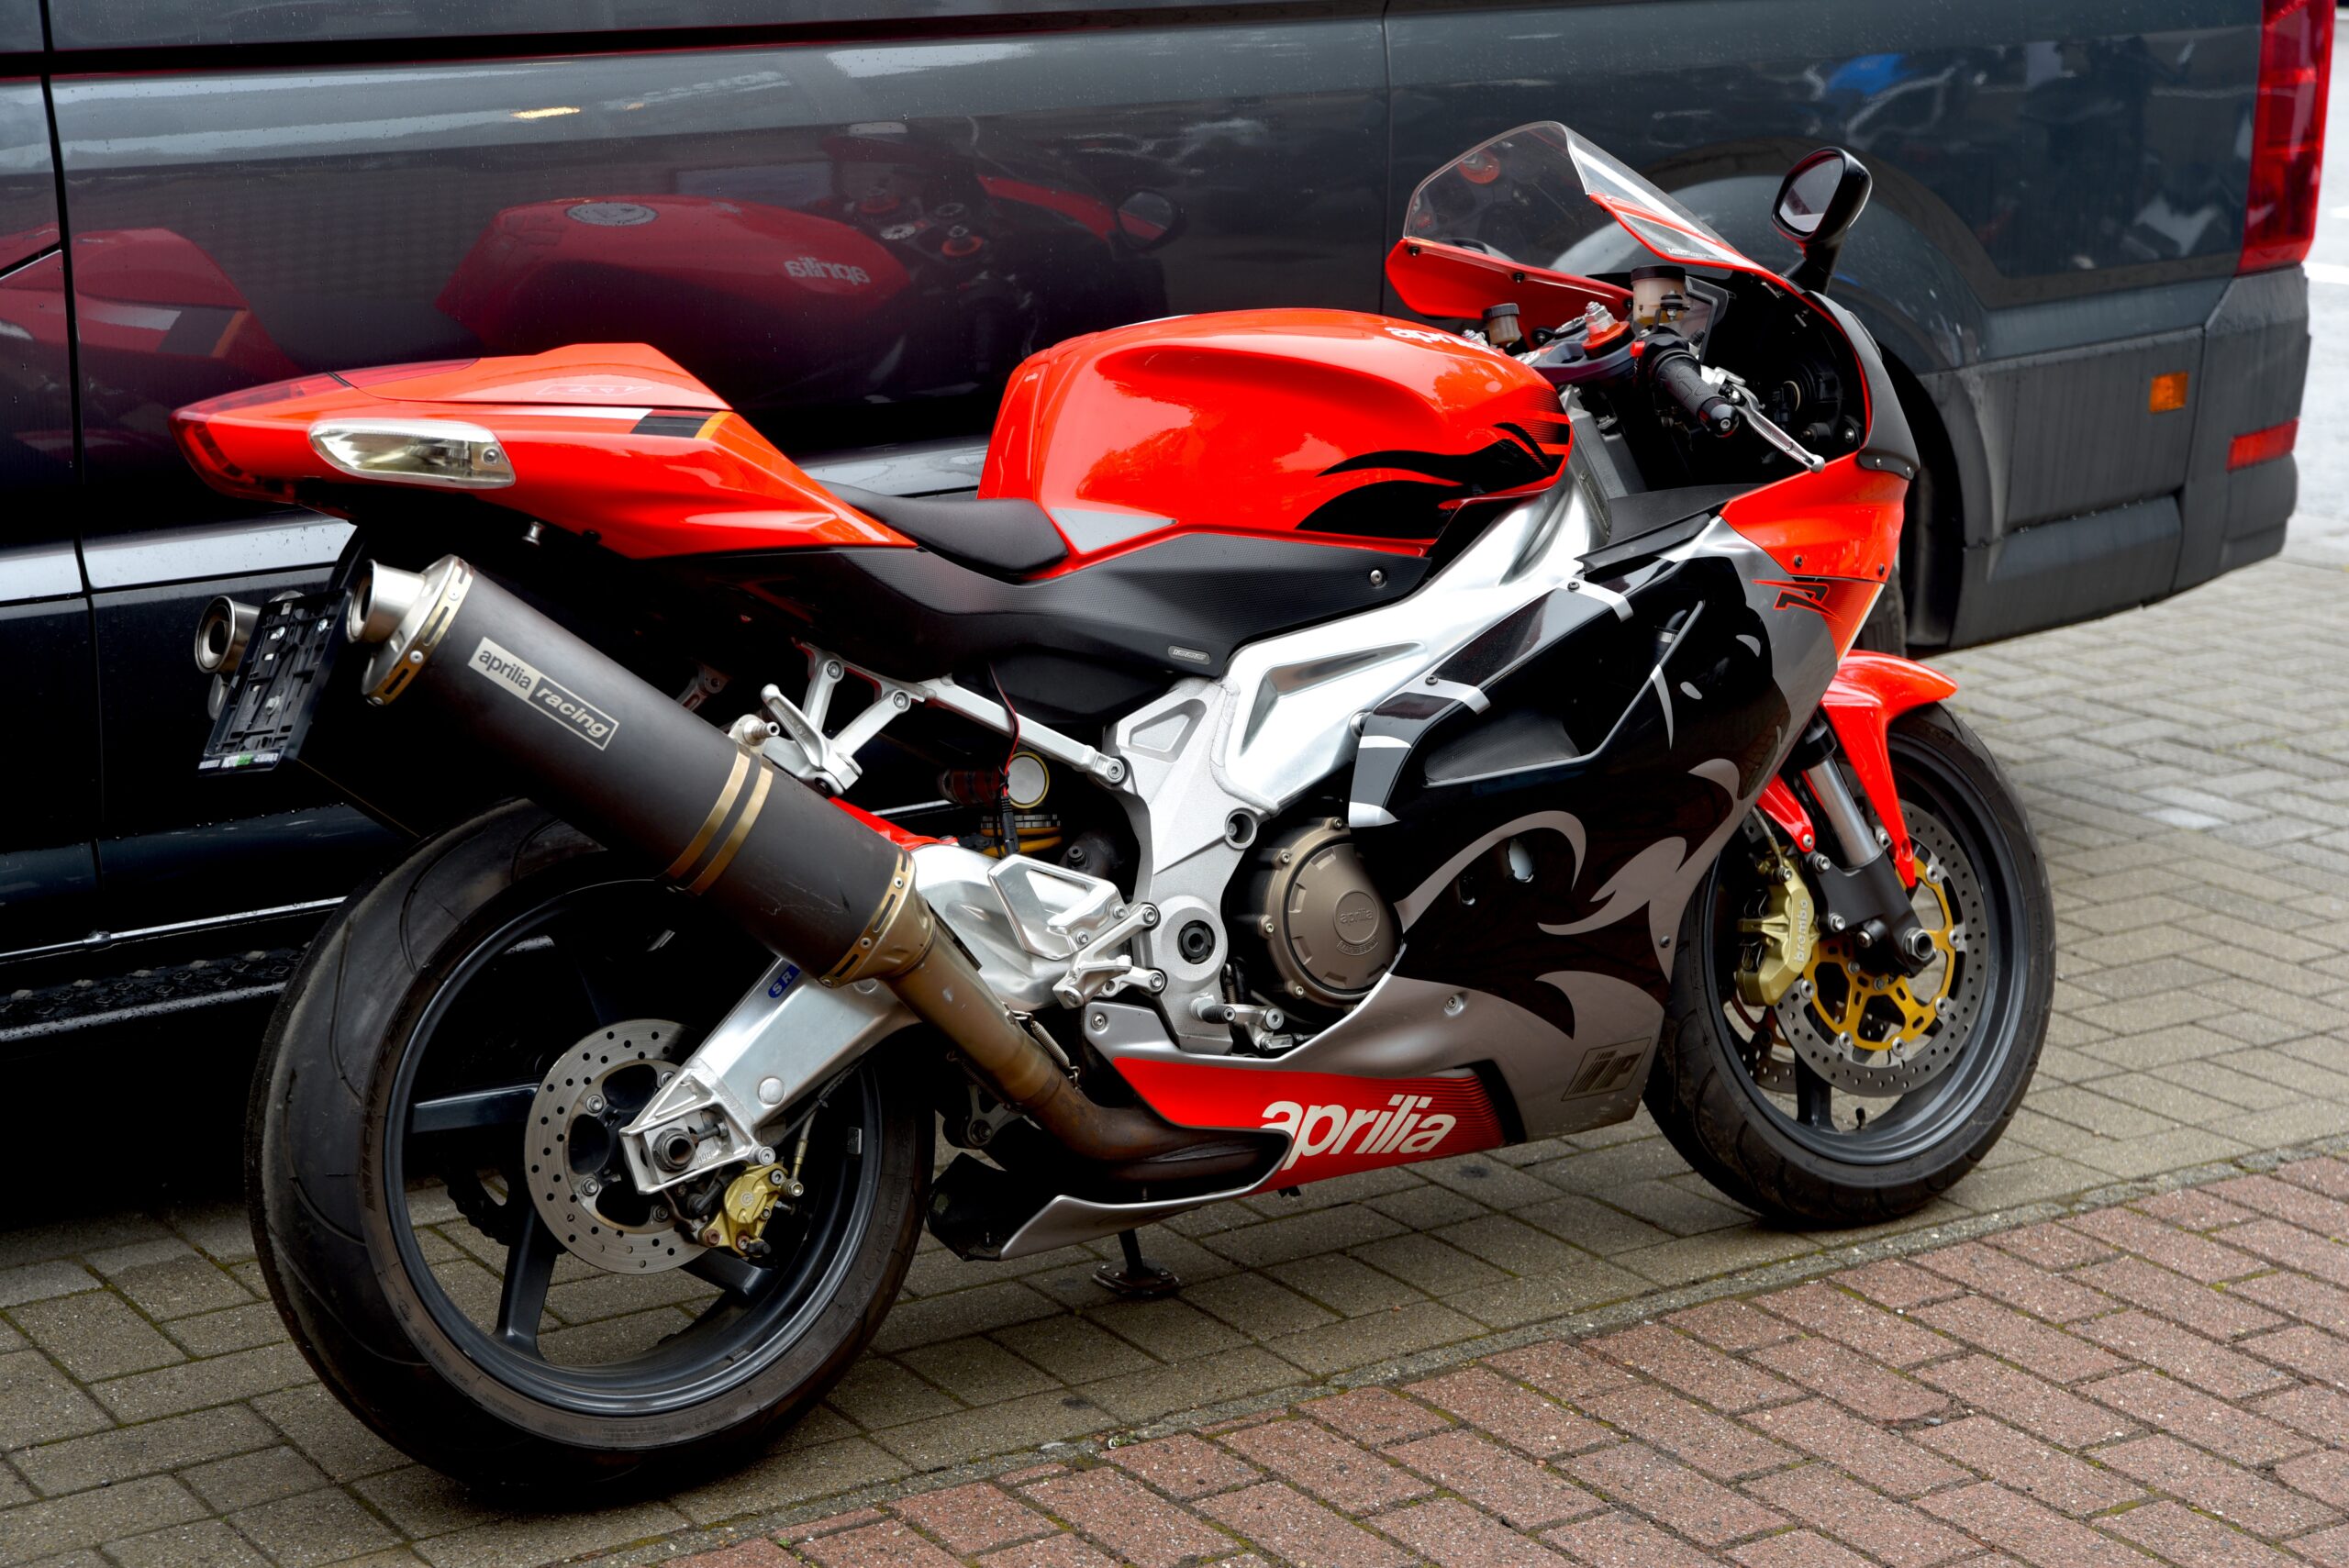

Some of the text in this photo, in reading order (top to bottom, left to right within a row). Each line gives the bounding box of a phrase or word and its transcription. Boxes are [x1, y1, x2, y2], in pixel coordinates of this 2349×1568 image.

[479, 649, 609, 738] aprilia racing
[1793, 899, 1809, 963] brembo
[1260, 1094, 1457, 1172] aprilia
